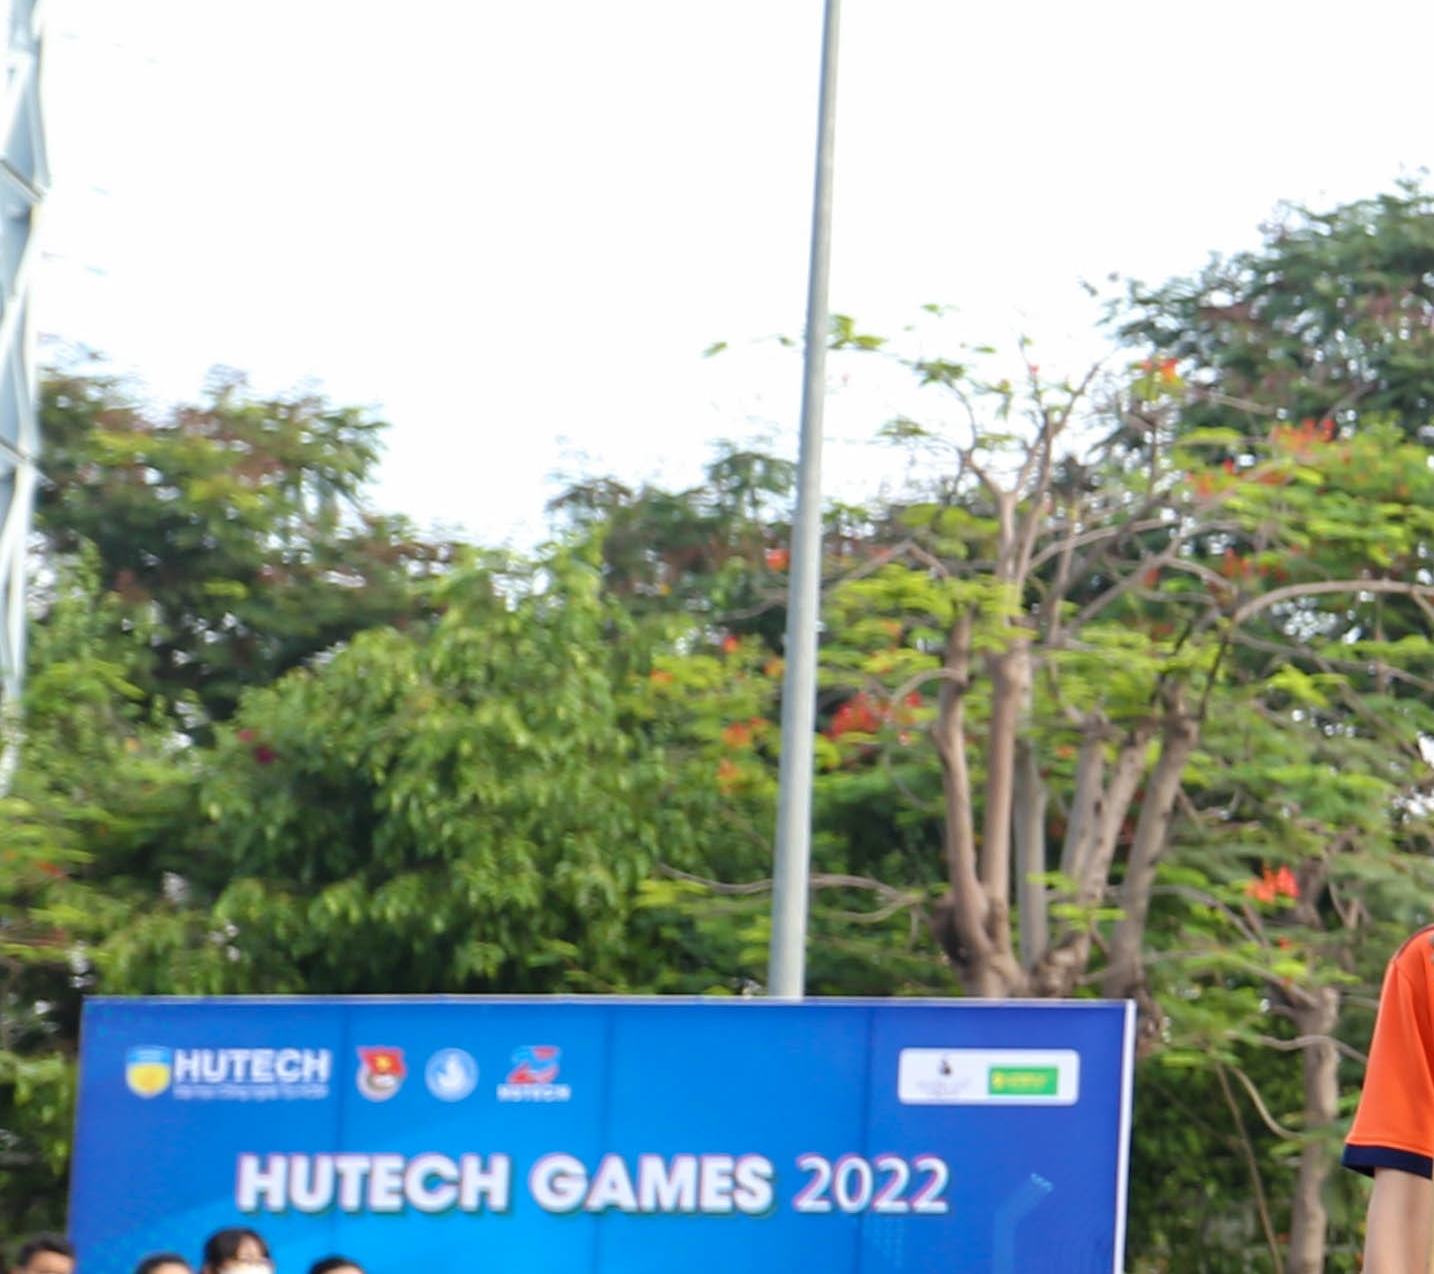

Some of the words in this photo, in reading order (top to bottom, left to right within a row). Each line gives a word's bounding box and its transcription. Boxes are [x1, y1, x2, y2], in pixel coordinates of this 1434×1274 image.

[174, 1048, 331, 1083] HUTECH
[497, 1084, 571, 1102] HUTECH
[235, 1152, 511, 1214] HUTECH
[529, 1152, 776, 1214] GAMES
[794, 1152, 949, 1214] 2022
